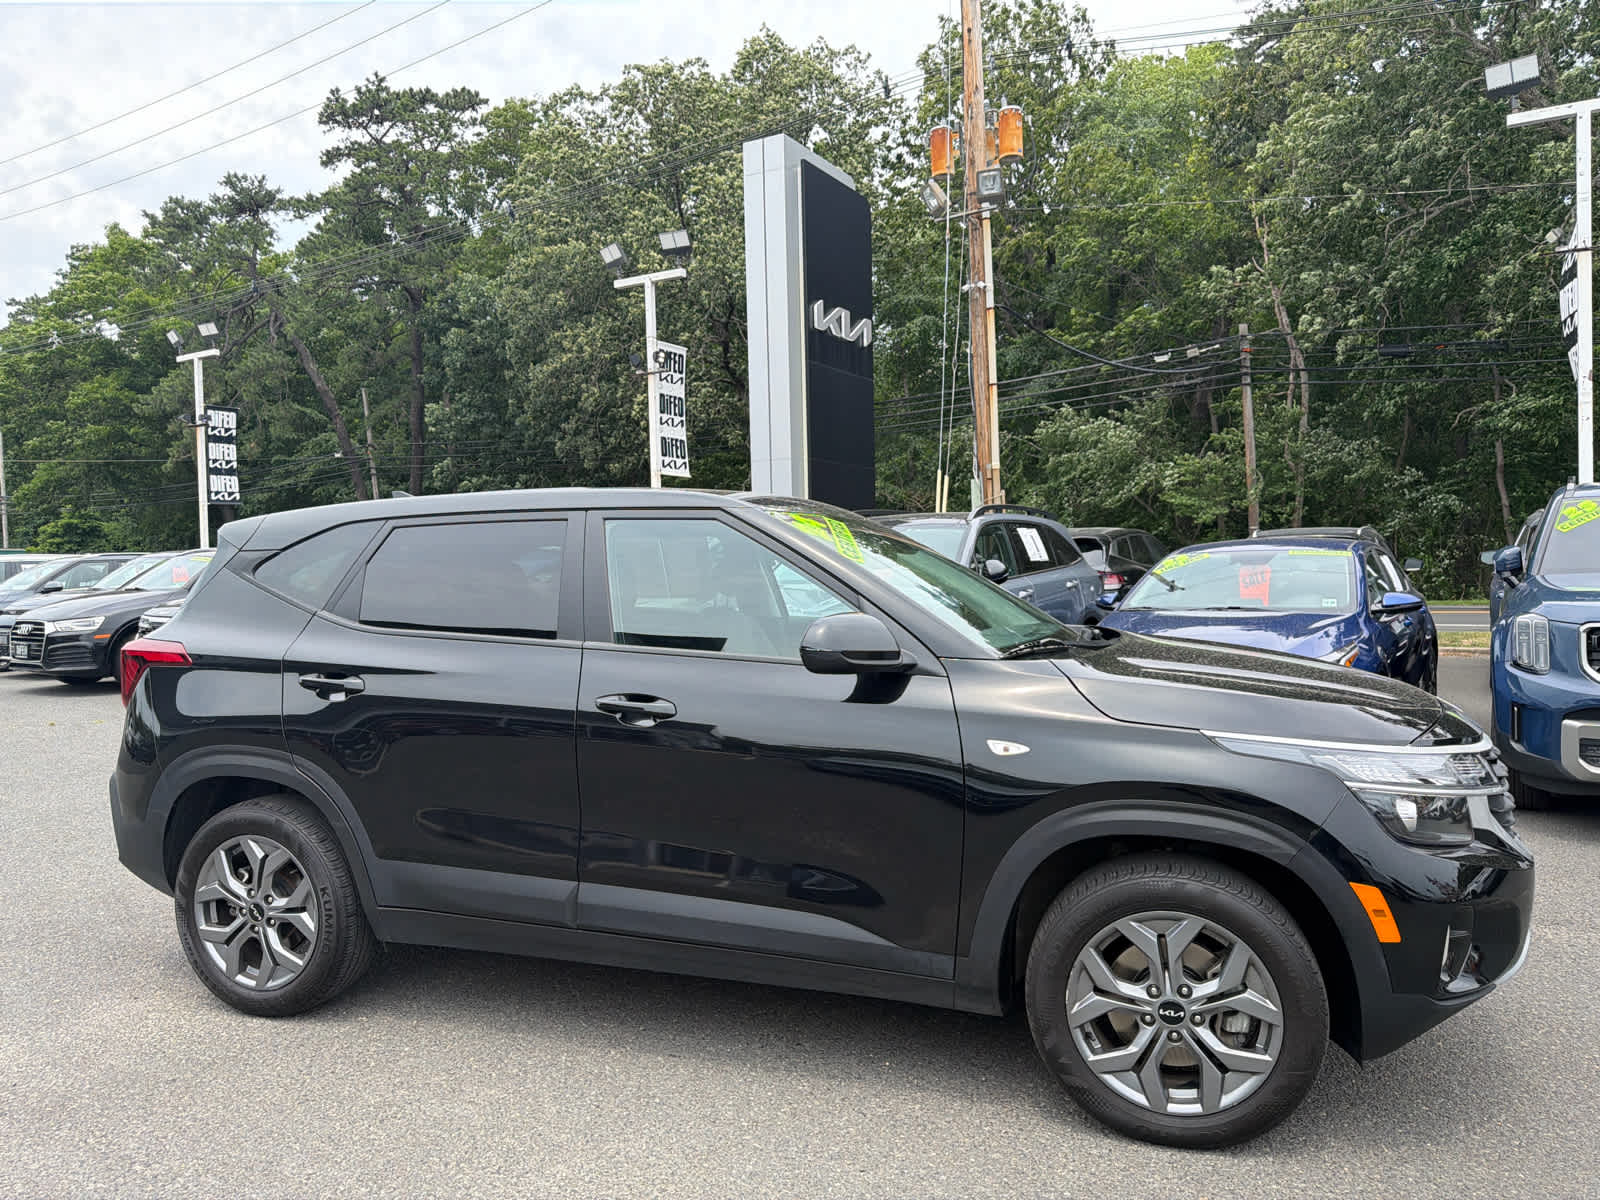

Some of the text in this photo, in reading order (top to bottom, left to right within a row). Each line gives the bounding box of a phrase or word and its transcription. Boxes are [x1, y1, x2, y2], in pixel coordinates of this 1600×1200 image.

[813, 299, 872, 347] KIA
[659, 373, 684, 385] KIA
[659, 416, 685, 428] KIA
[207, 427, 237, 437] KIA
[208, 459, 238, 469] KIA
[661, 459, 688, 470] KIA
[210, 491, 241, 501] KIA
[1159, 1008, 1185, 1018] KIA
